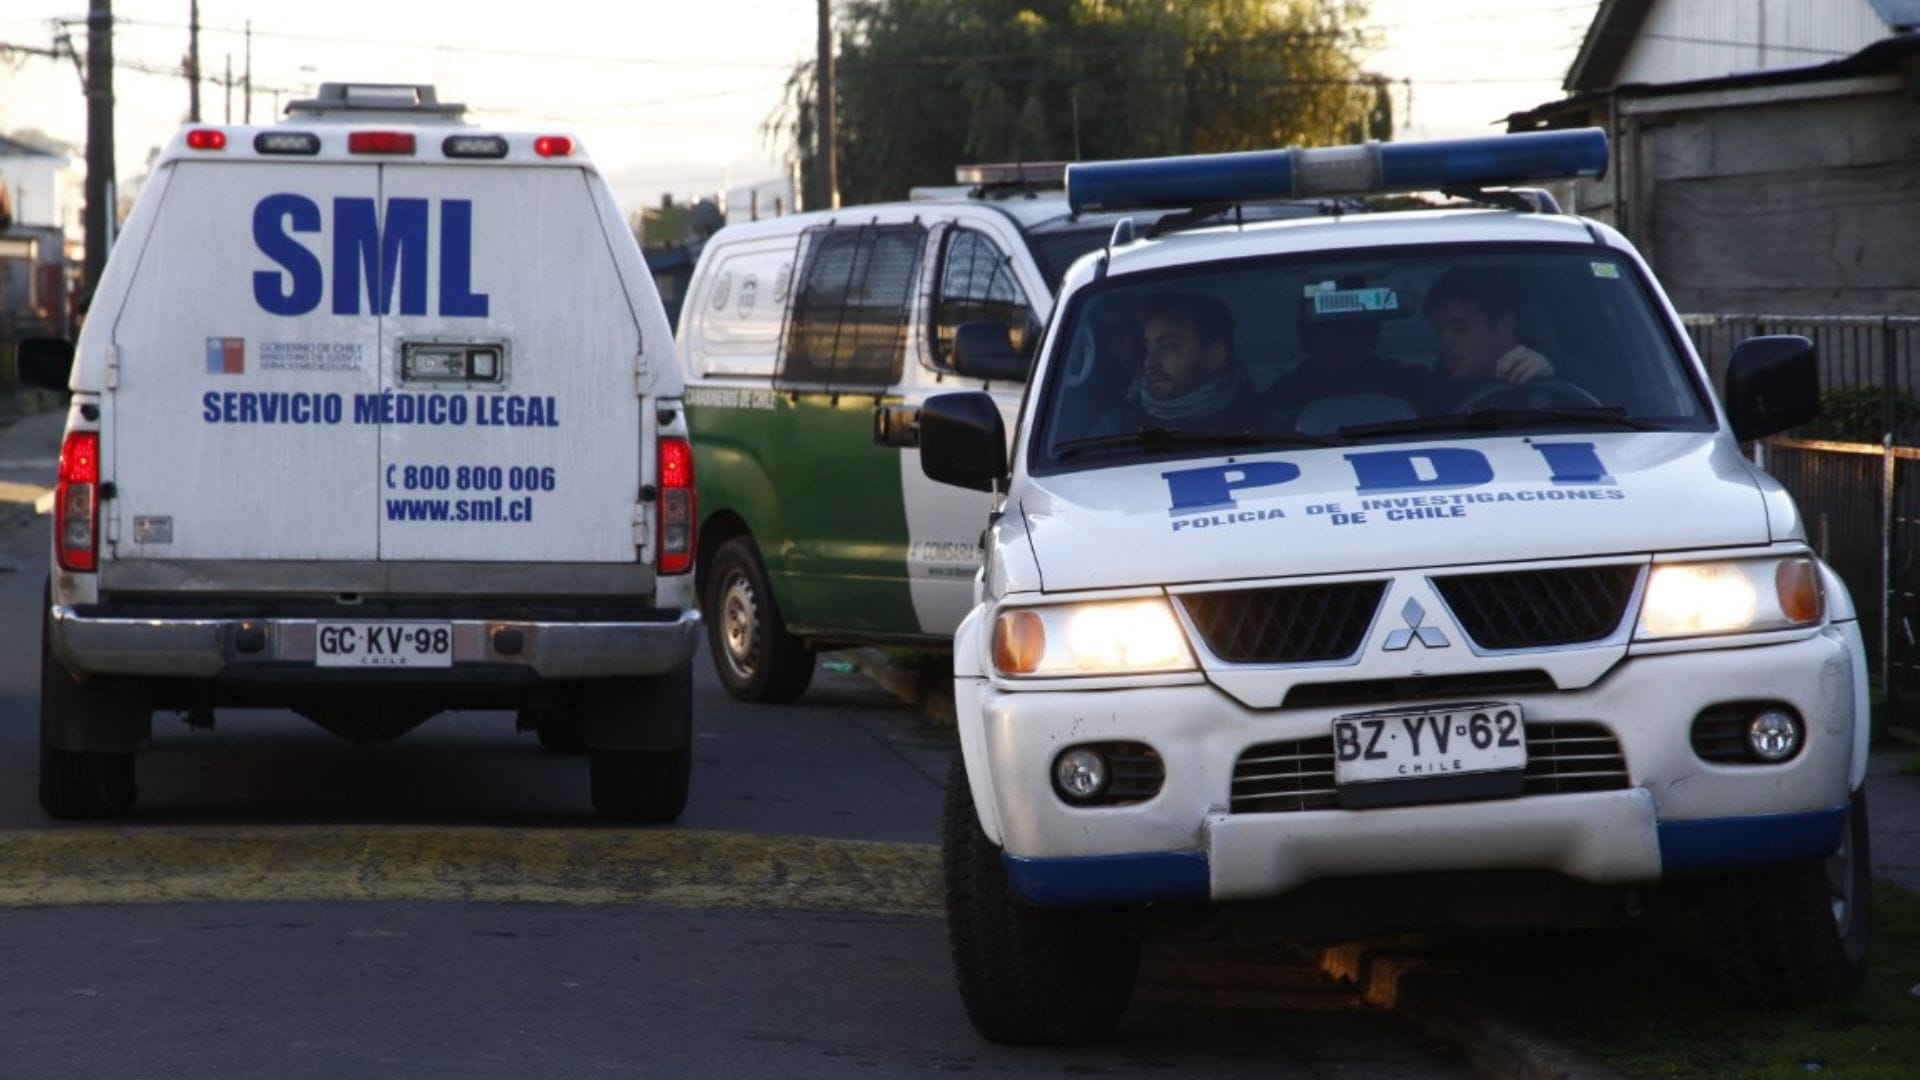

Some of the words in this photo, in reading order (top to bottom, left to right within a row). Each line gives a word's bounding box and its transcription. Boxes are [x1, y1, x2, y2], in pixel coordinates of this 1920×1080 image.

[252, 192, 489, 317] SML
[203, 390, 342, 424] SERVICIO
[354, 387, 468, 425] MÉDICO
[475, 394, 559, 427] LEGAL
[403, 465, 451, 490] 800
[456, 465, 502, 491] 800
[508, 466, 556, 492] 006
[386, 496, 532, 522] www.sml.cl
[1172, 508, 1286, 531] POLICIA
[1306, 501, 1342, 516] DE
[1361, 488, 1626, 511] INVESTIGACIONES
[1331, 511, 1367, 526] DE
[1387, 505, 1467, 522] CHILE
[1398, 759, 1462, 774] CHILE
